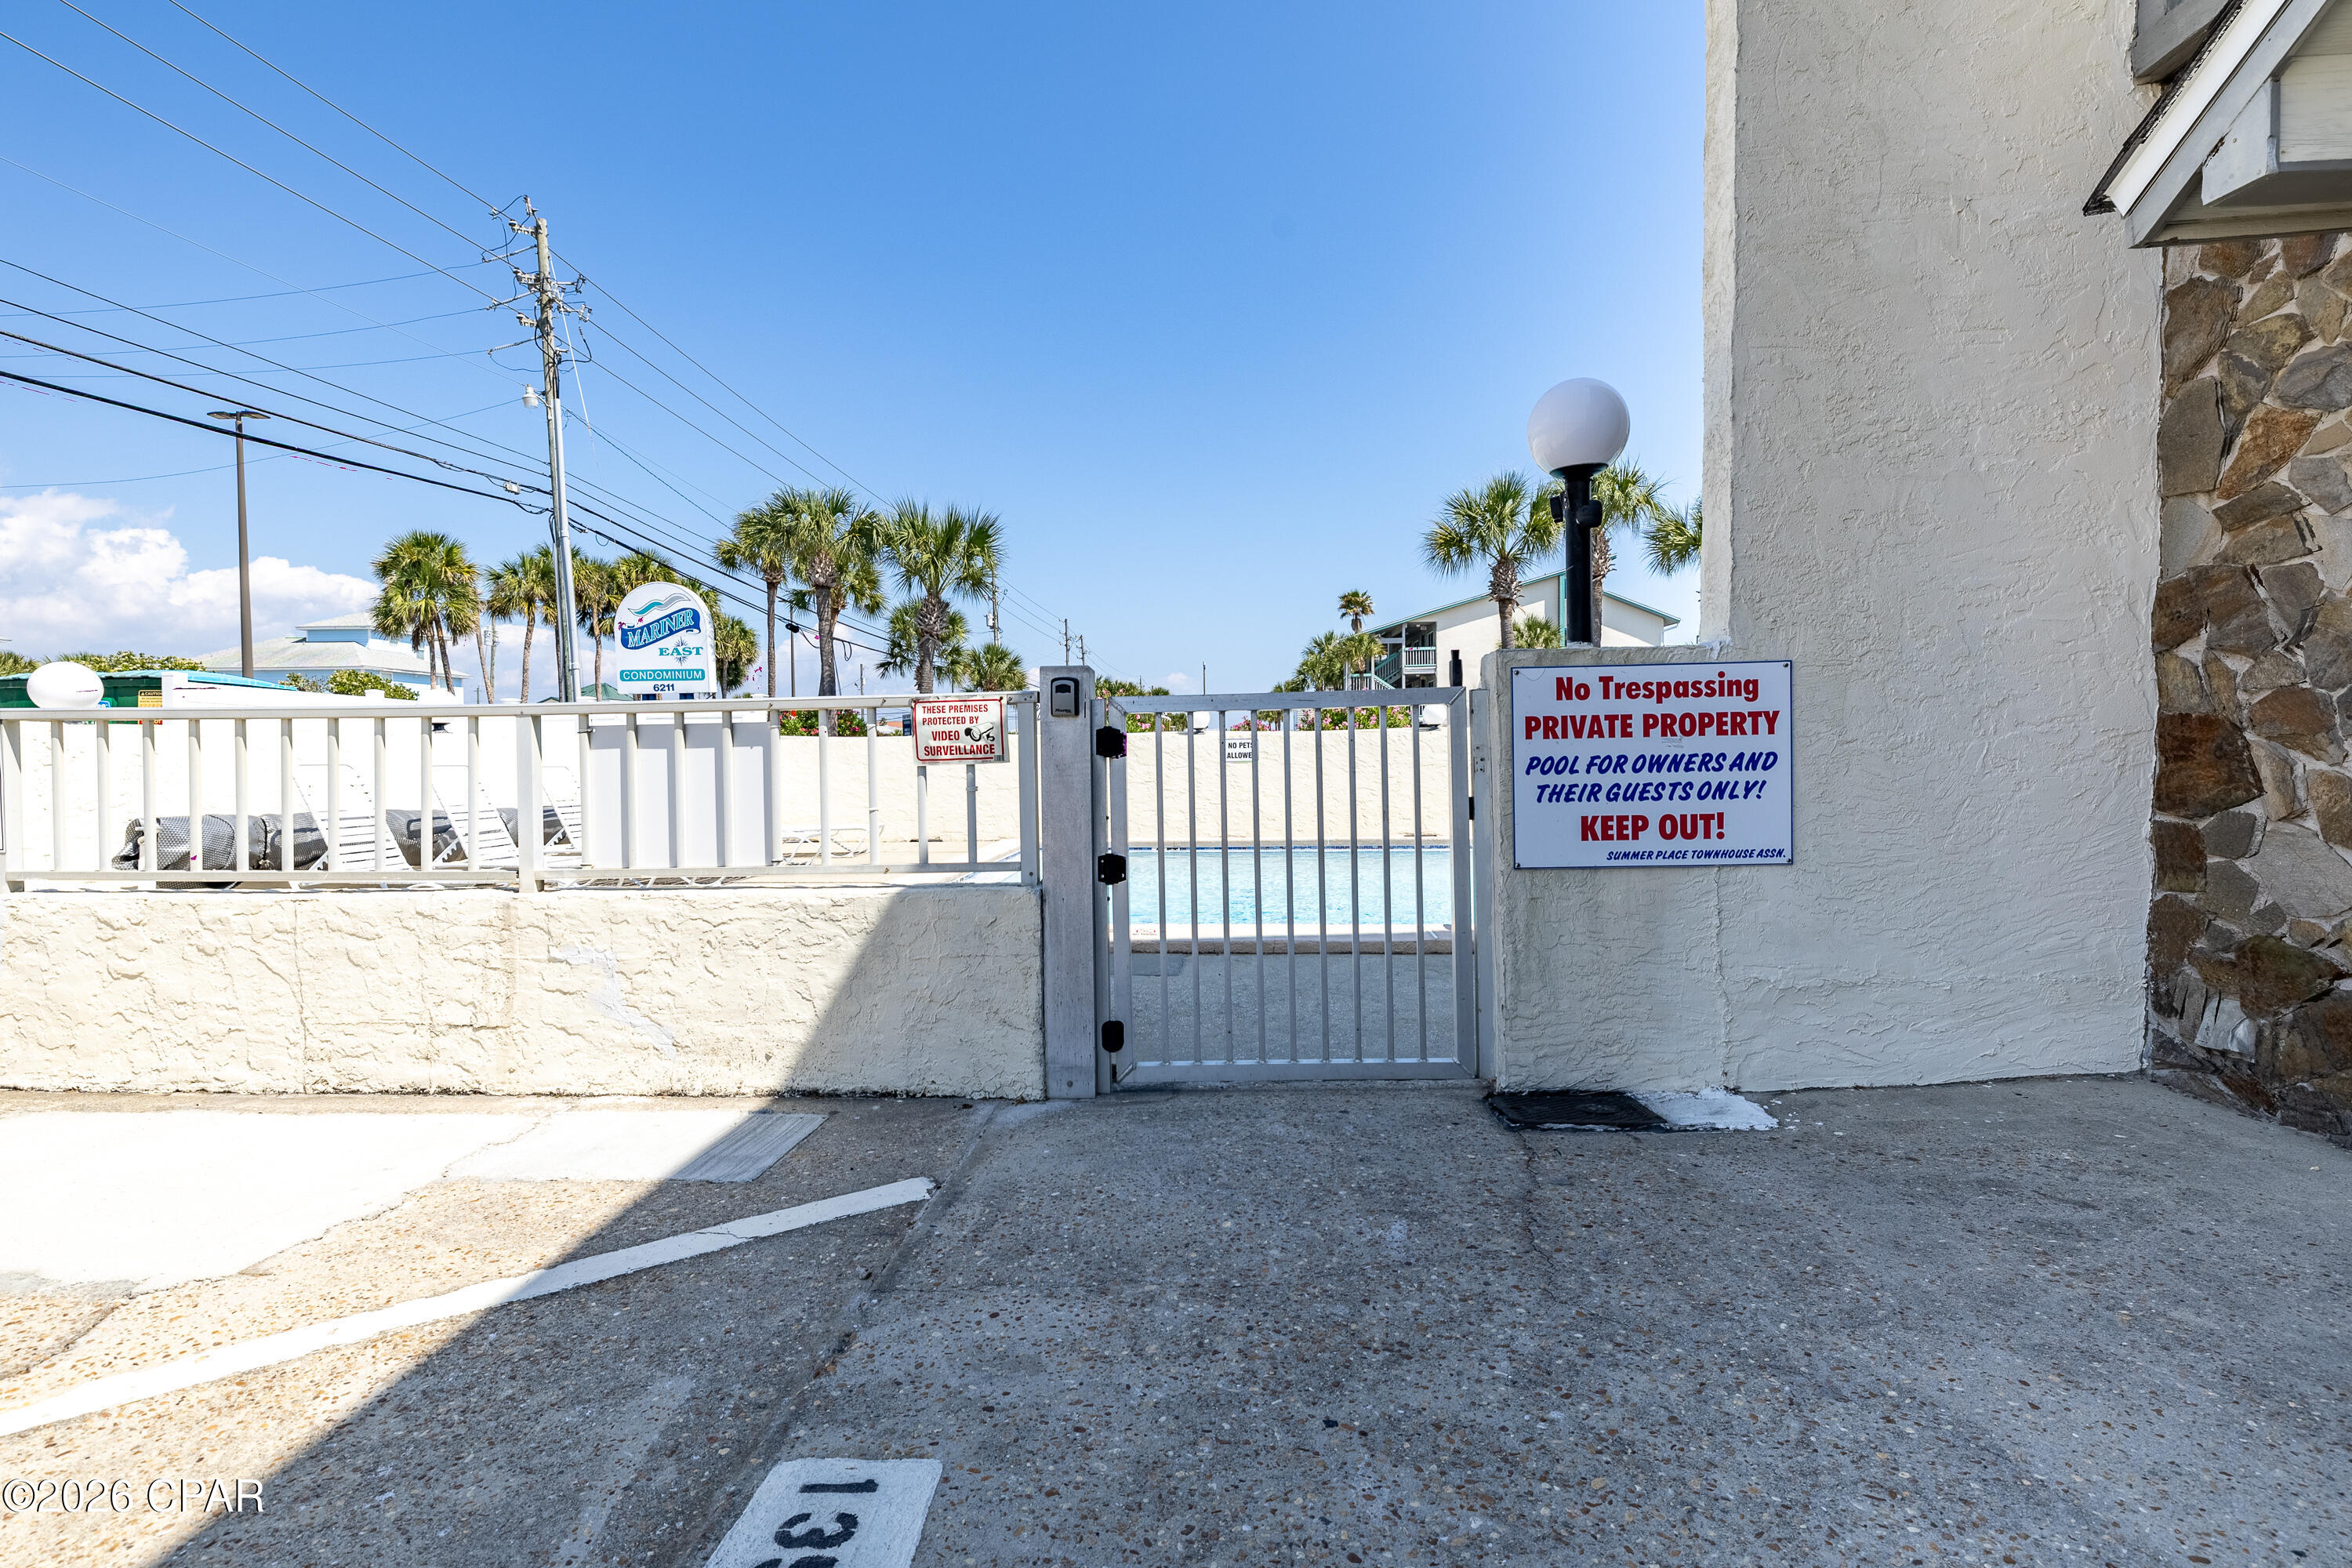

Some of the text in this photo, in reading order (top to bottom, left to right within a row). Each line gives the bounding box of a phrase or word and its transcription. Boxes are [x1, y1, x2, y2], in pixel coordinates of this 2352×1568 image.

[627, 609, 695, 648] MARINER
[659, 646, 704, 656] EAST
[622, 670, 702, 680] CONDOMINIUM
[1555, 671, 1759, 704] No Trespassing
[922, 704, 989, 714] THESE PREMISES
[922, 717, 966, 725] PROTECTED
[1525, 710, 1780, 740] PRIVATE PROPERTY
[931, 730, 960, 741] VIDEO
[924, 744, 995, 756] SURVEILLANCE
[1525, 751, 1778, 775] POOL FOR OWNERS AND
[1537, 779, 1767, 803] THEIR GUESTS ONLY!
[1581, 811, 1725, 841] KEEP OUT!
[1606, 848, 1786, 860] SUMMER PLACE TOWNHOUSE ASSN.
